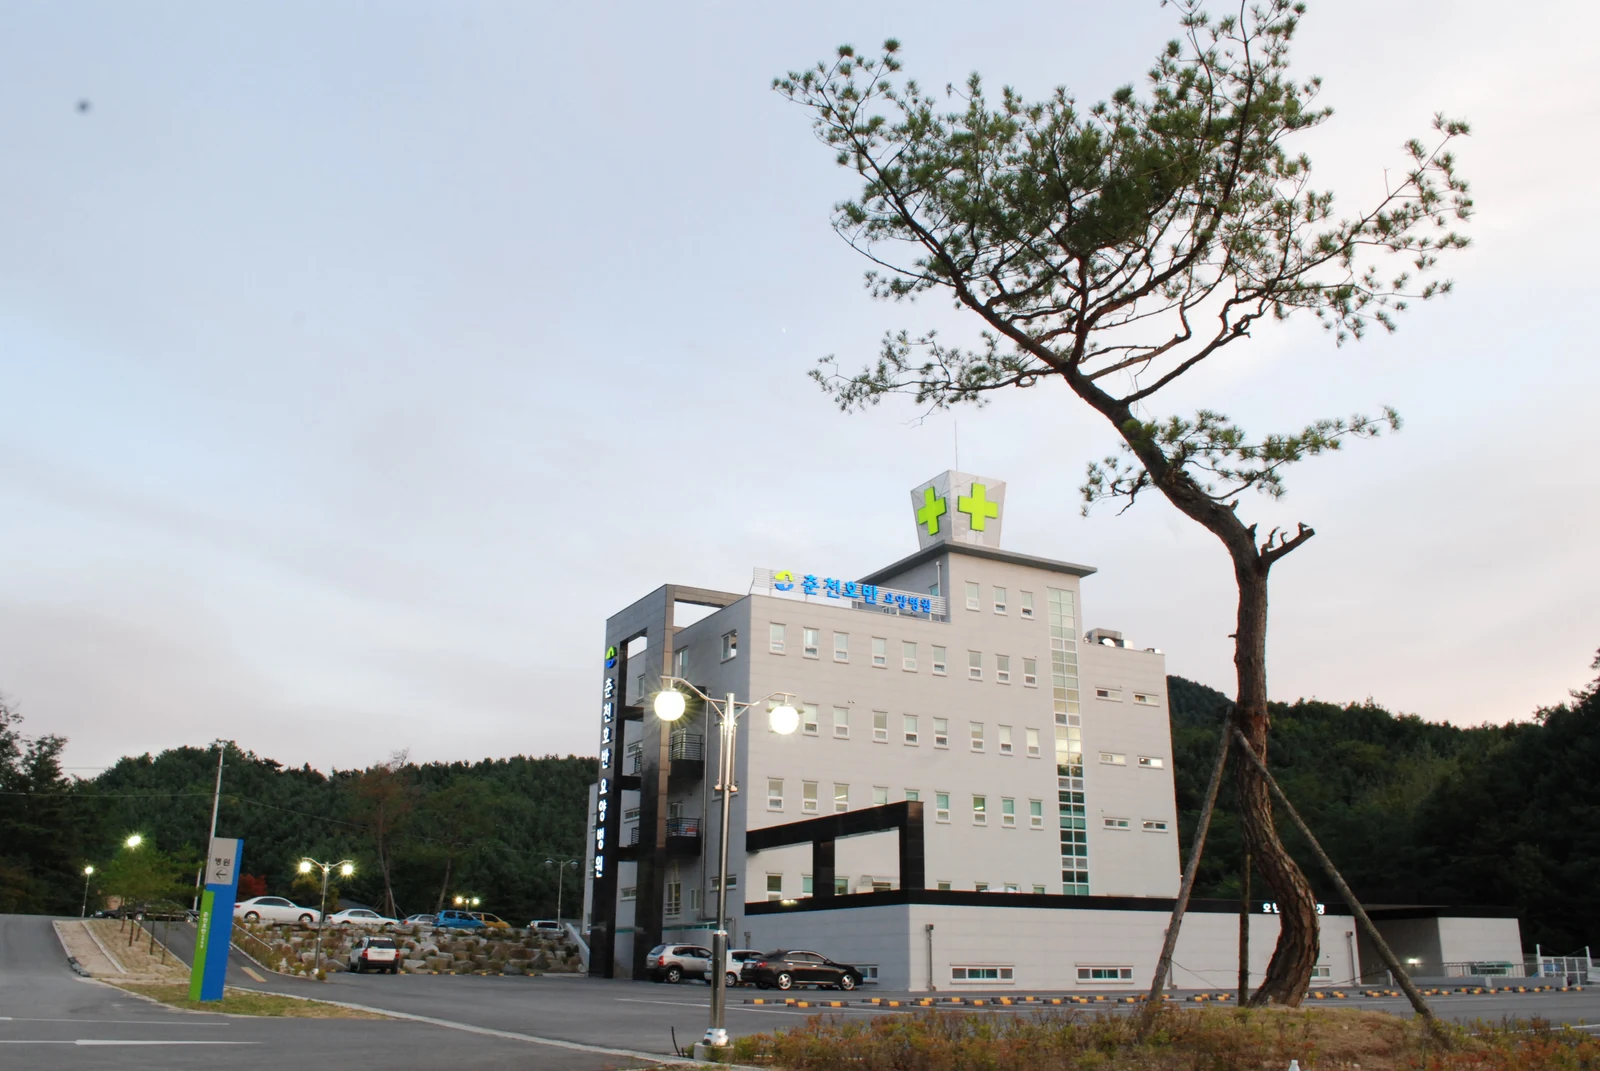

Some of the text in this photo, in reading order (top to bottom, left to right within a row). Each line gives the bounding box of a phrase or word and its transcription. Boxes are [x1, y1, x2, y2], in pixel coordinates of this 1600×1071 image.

[801, 574, 932, 613] 춘천호반 요양병원
[215, 857, 231, 867] 병원
